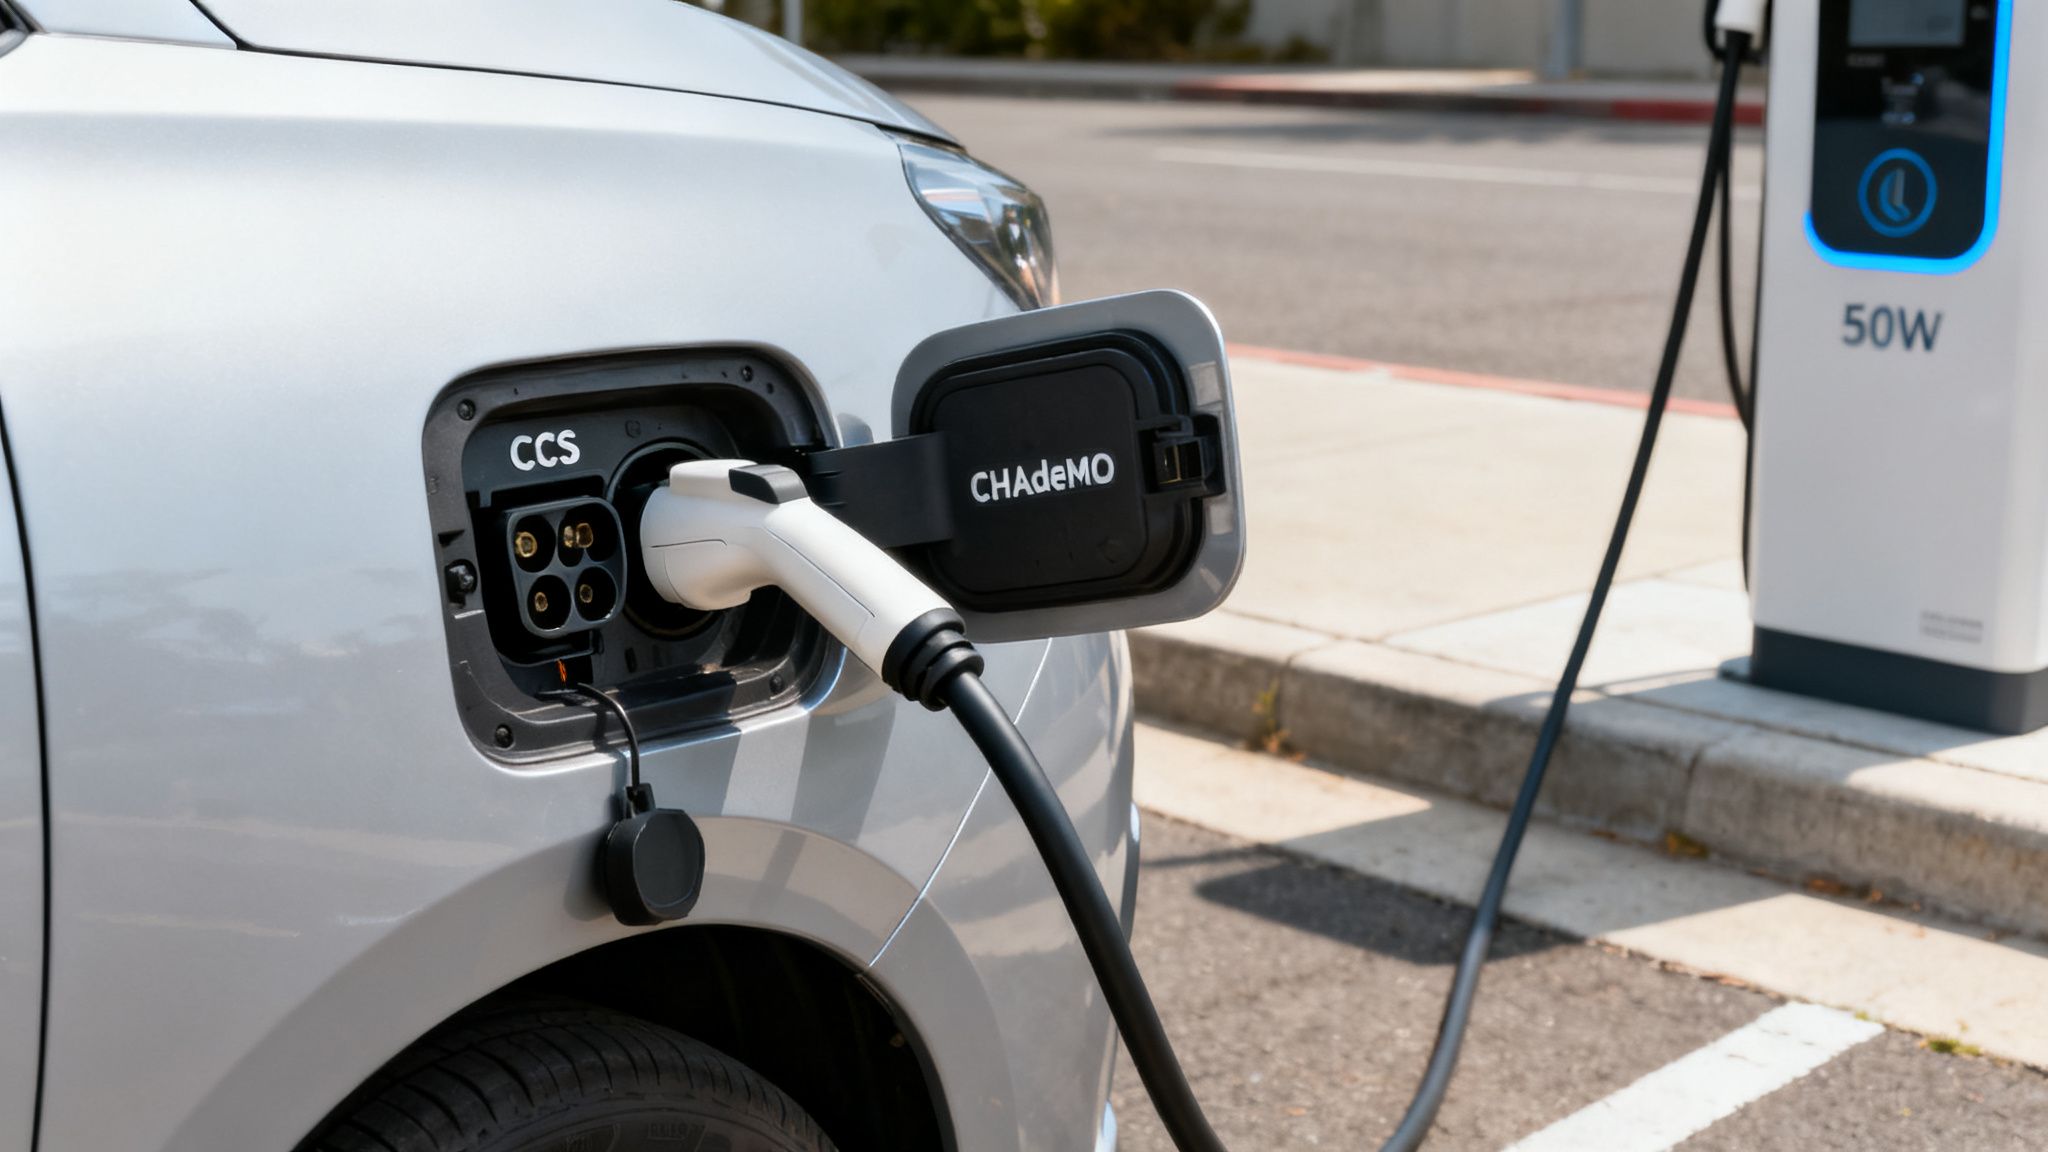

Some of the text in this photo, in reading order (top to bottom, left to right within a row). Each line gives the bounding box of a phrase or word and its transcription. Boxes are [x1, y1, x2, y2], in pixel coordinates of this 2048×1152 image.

[1842, 303, 1943, 352] 50W
[510, 429, 581, 471] CCS
[970, 452, 1115, 503] CHAdeMO
